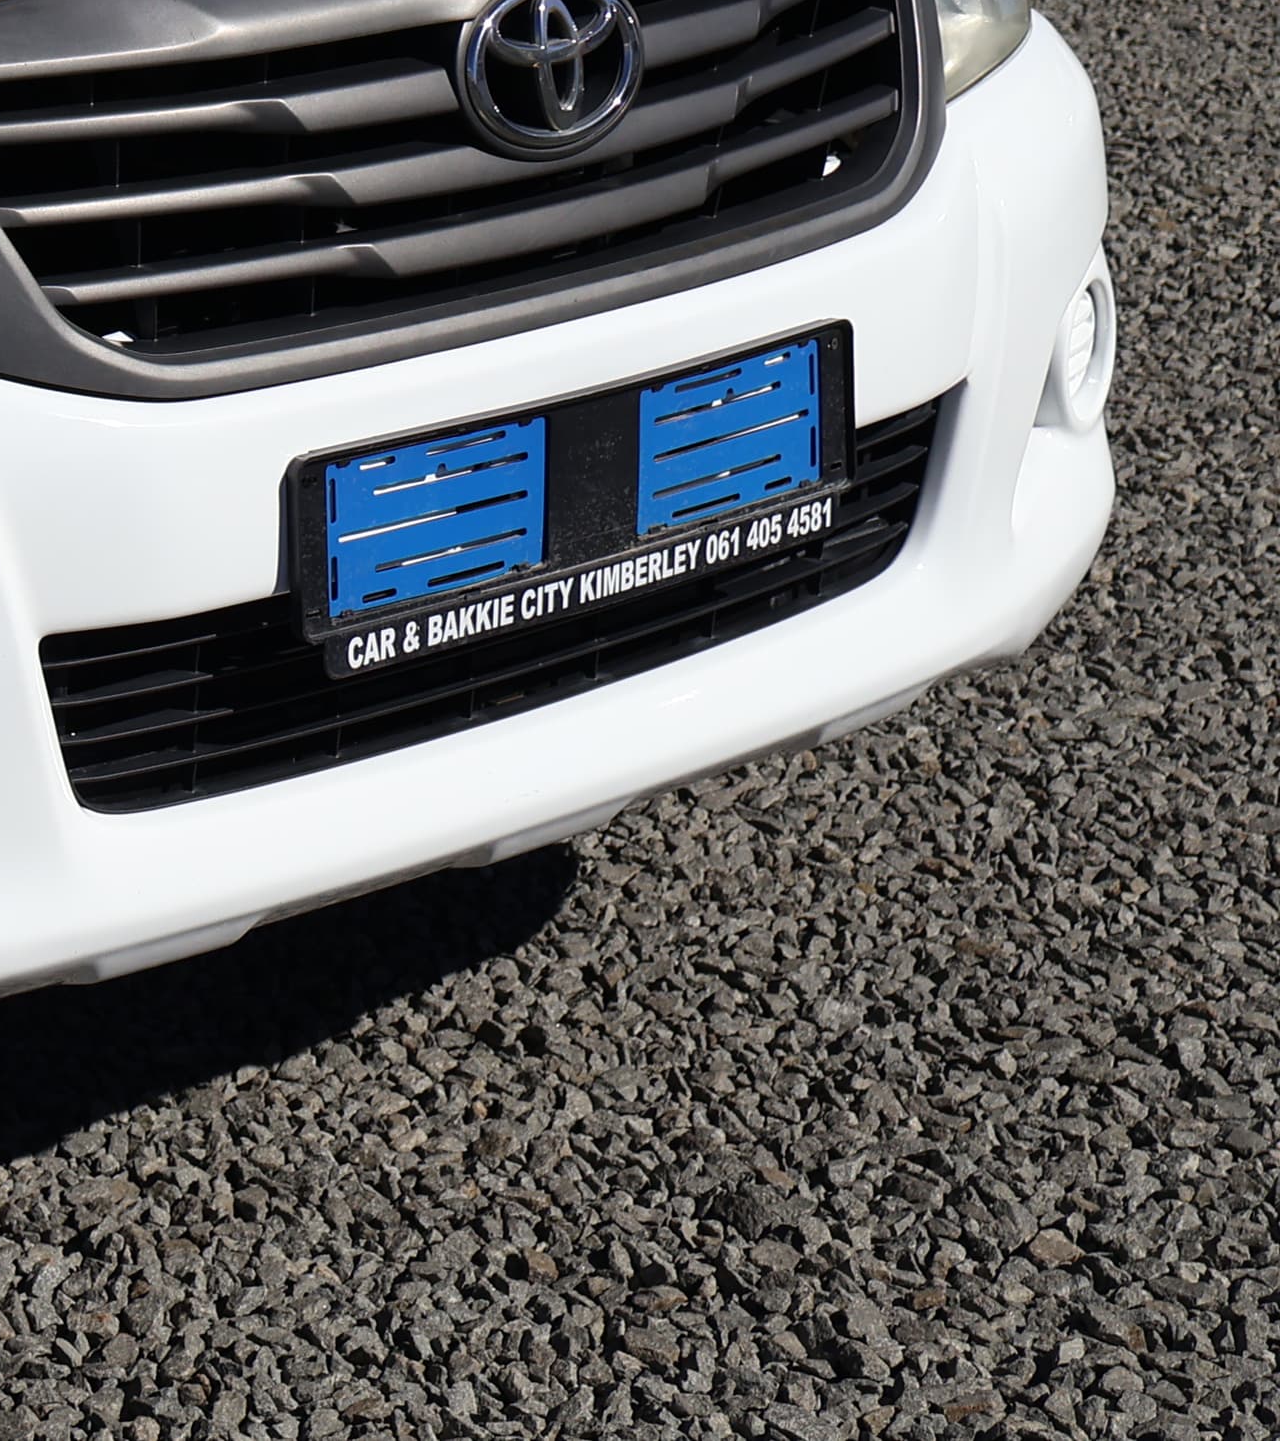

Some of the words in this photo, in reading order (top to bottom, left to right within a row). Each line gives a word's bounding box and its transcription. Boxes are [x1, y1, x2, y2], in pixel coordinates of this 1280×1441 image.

[347, 627, 396, 669] CAR
[403, 621, 420, 654] &
[427, 594, 515, 647] BAKKIE
[521, 577, 575, 620] CITY
[579, 539, 701, 604] KIMBERLEY
[705, 526, 740, 564] 061
[746, 514, 783, 551] 405
[786, 497, 833, 538] 4581
